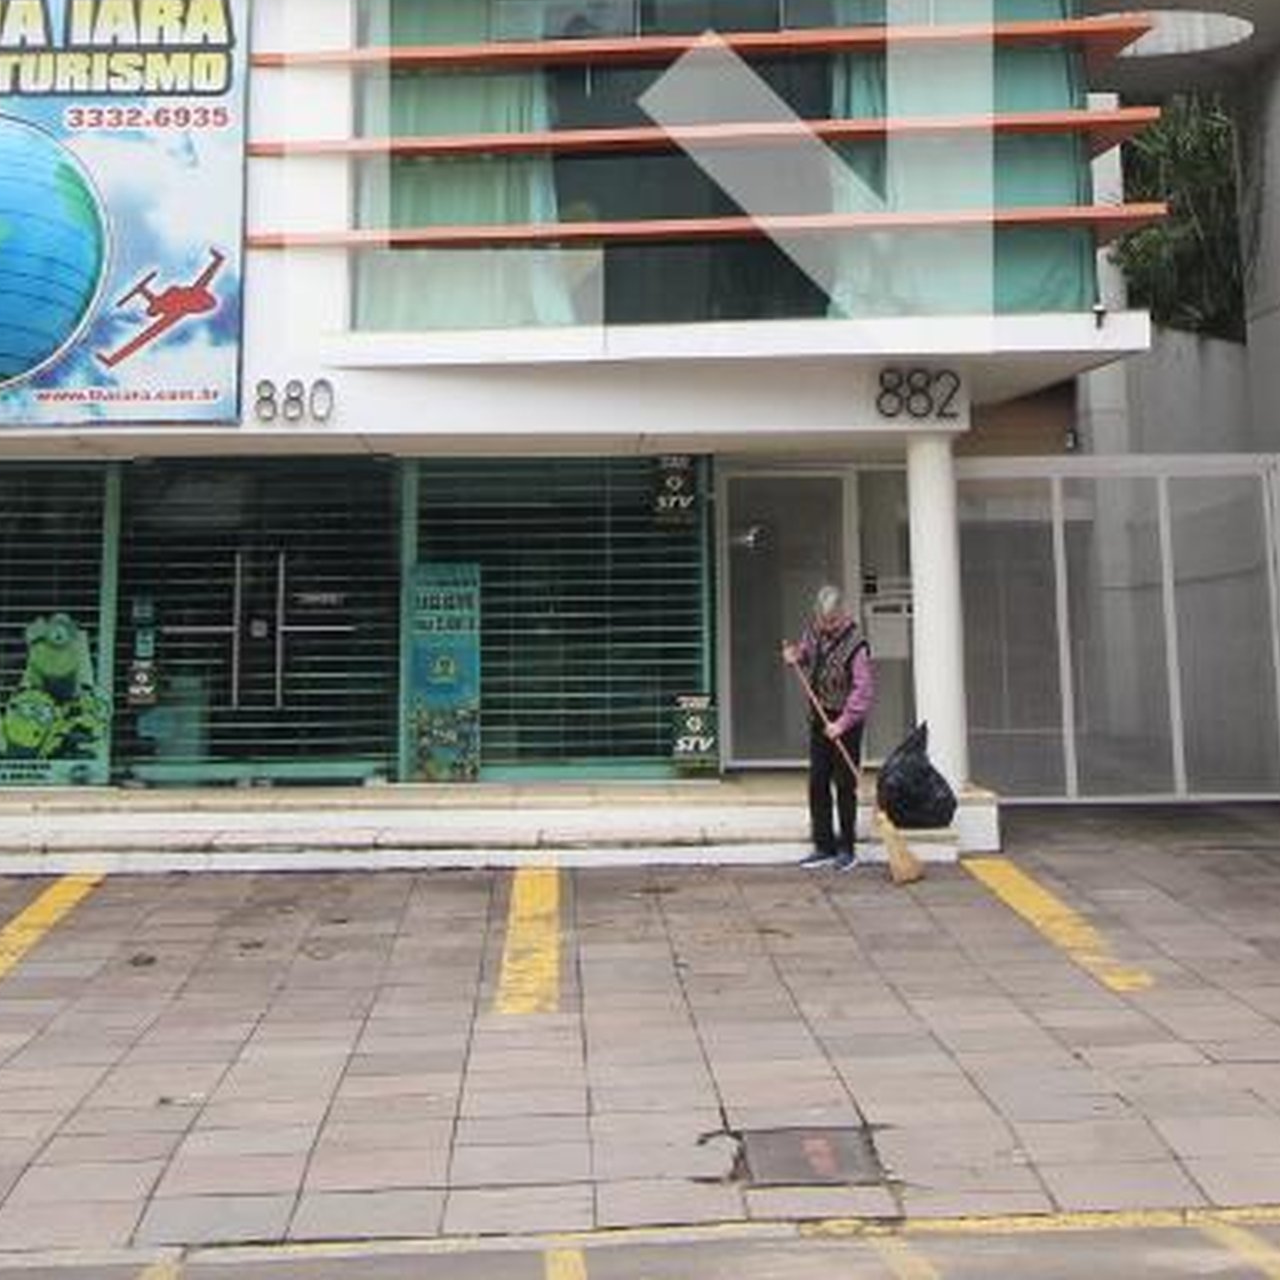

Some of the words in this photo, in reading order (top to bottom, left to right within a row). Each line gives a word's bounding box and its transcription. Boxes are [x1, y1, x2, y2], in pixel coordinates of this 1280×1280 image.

[67, 106, 229, 128] 3332.6935
[255, 379, 334, 422] 880
[875, 368, 961, 418] 882
[673, 736, 715, 752] STV
